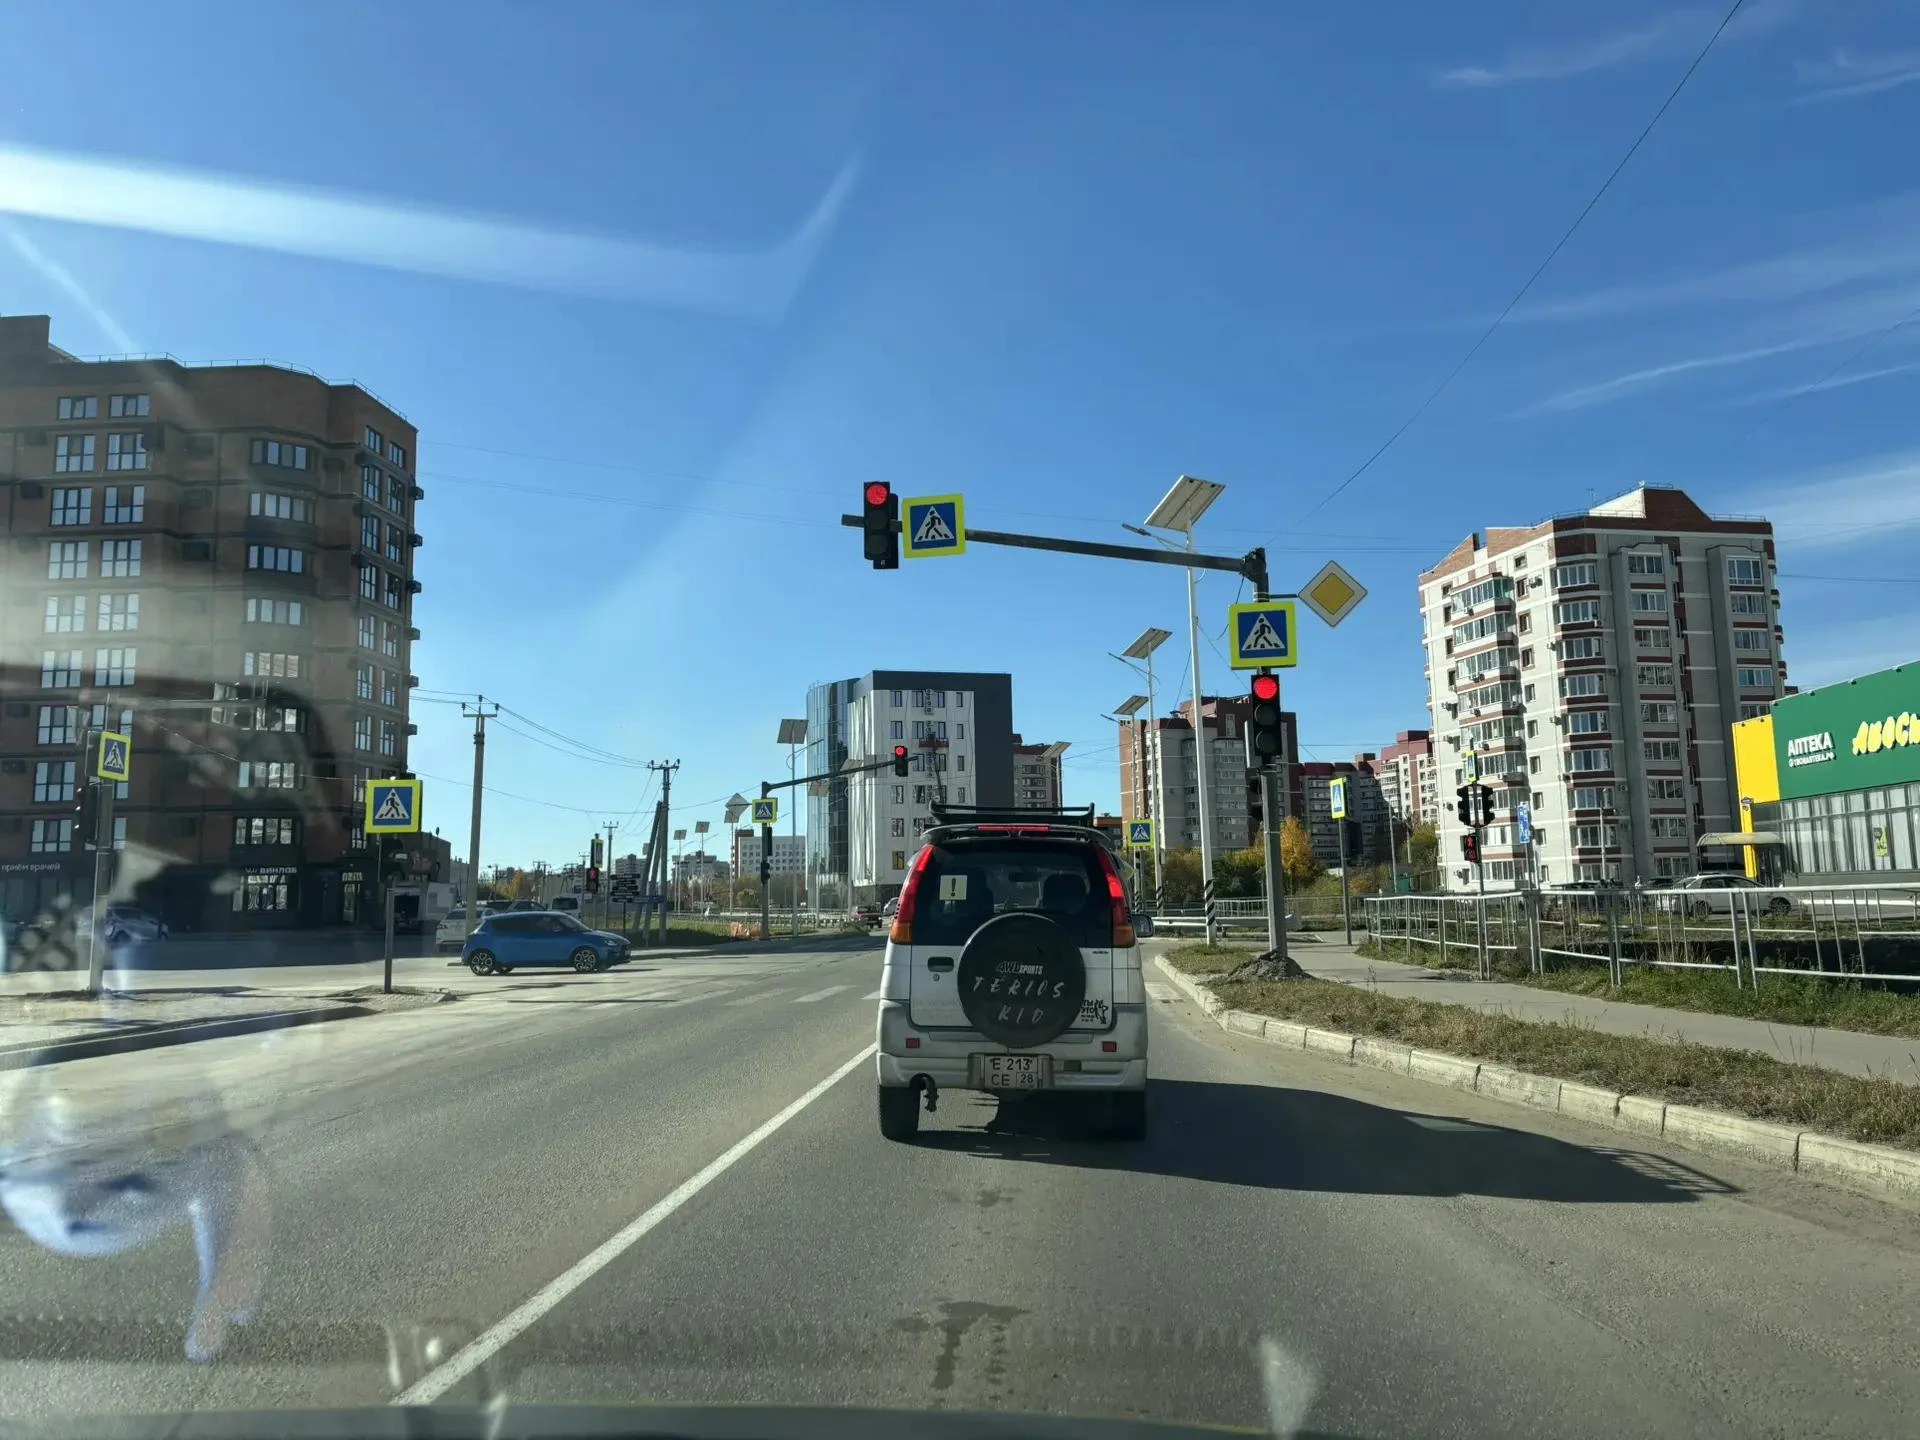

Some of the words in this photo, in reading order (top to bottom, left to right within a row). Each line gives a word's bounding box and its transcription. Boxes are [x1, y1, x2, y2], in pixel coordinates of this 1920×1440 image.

[1788, 732, 1833, 757] АПТЕКА
[973, 976, 1064, 998] TERIOS
[998, 1004, 1043, 1024] KID
[1006, 1058, 1031, 1071] 213
[1020, 1073, 1034, 1084] 28
